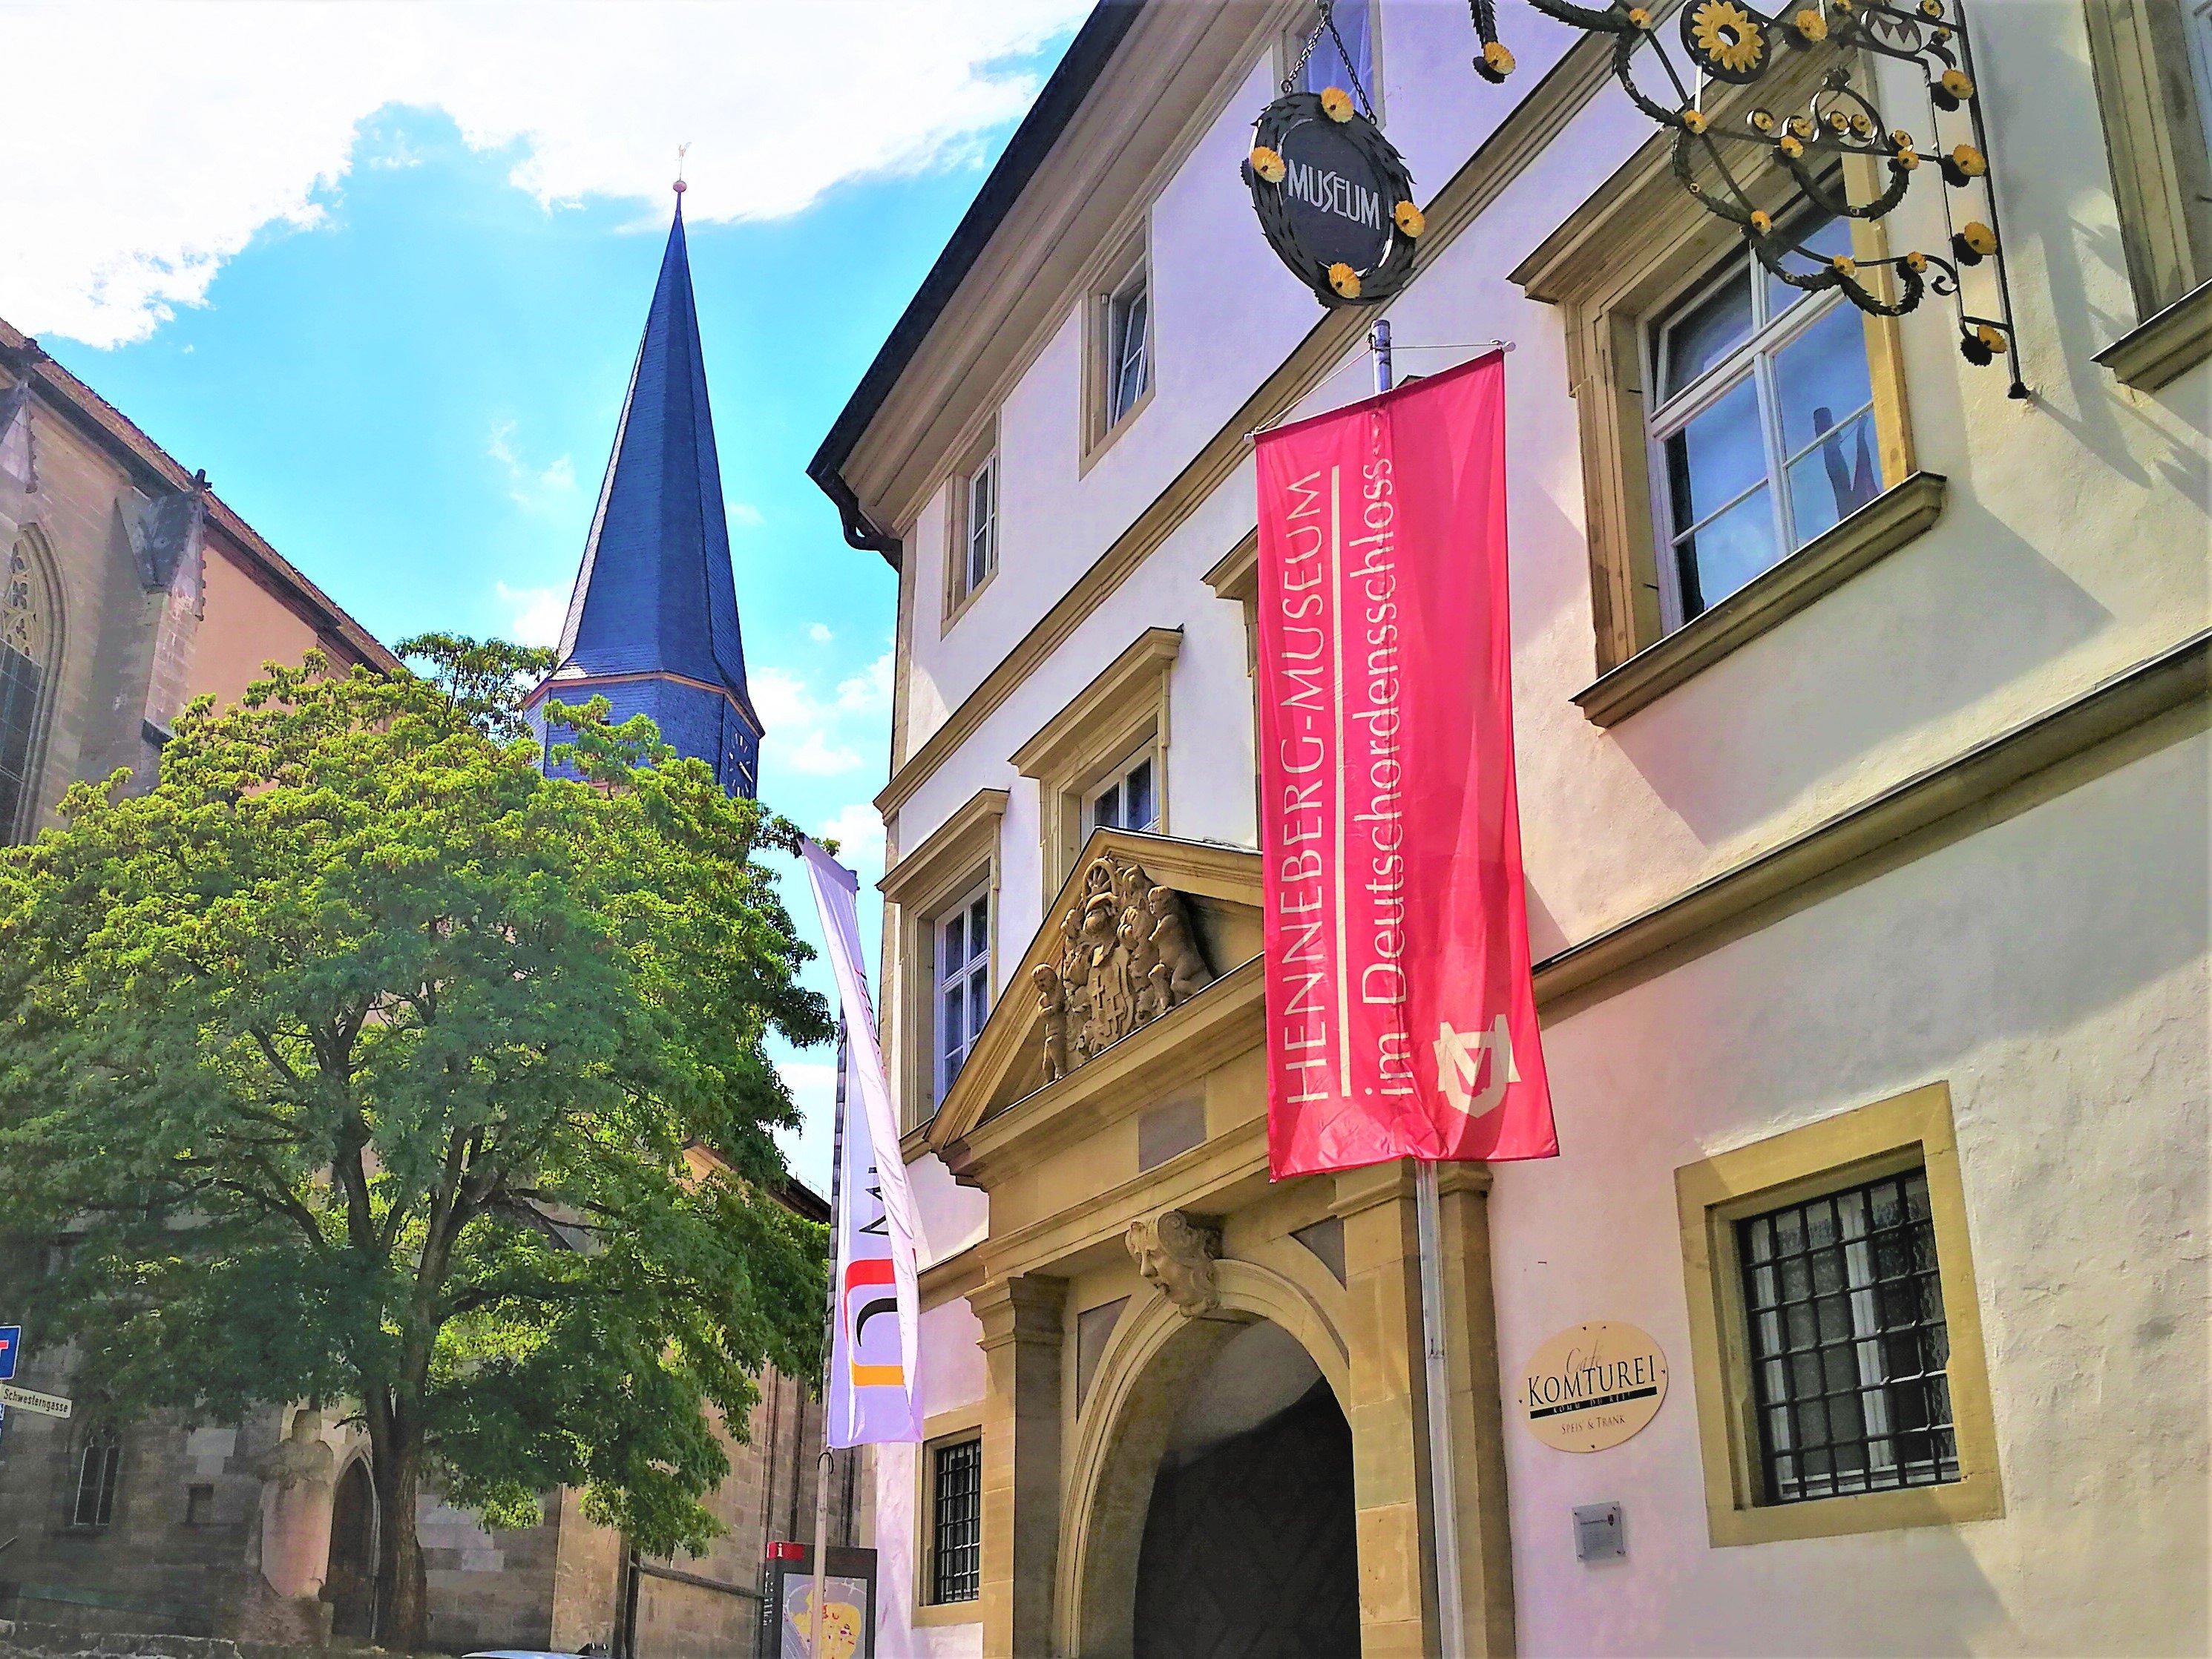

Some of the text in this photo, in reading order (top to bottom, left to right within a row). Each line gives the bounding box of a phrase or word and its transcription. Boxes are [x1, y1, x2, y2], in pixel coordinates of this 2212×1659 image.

[1288, 159, 1381, 230] MUSEUM
[1280, 470, 1328, 1104] HENNEBERG-MUSEUM
[1348, 458, 1414, 1097] im Deutschordensschloss
[3, 1387, 69, 1413] Schwesterngasse
[1527, 1355, 1656, 1407] KOMTUREI
